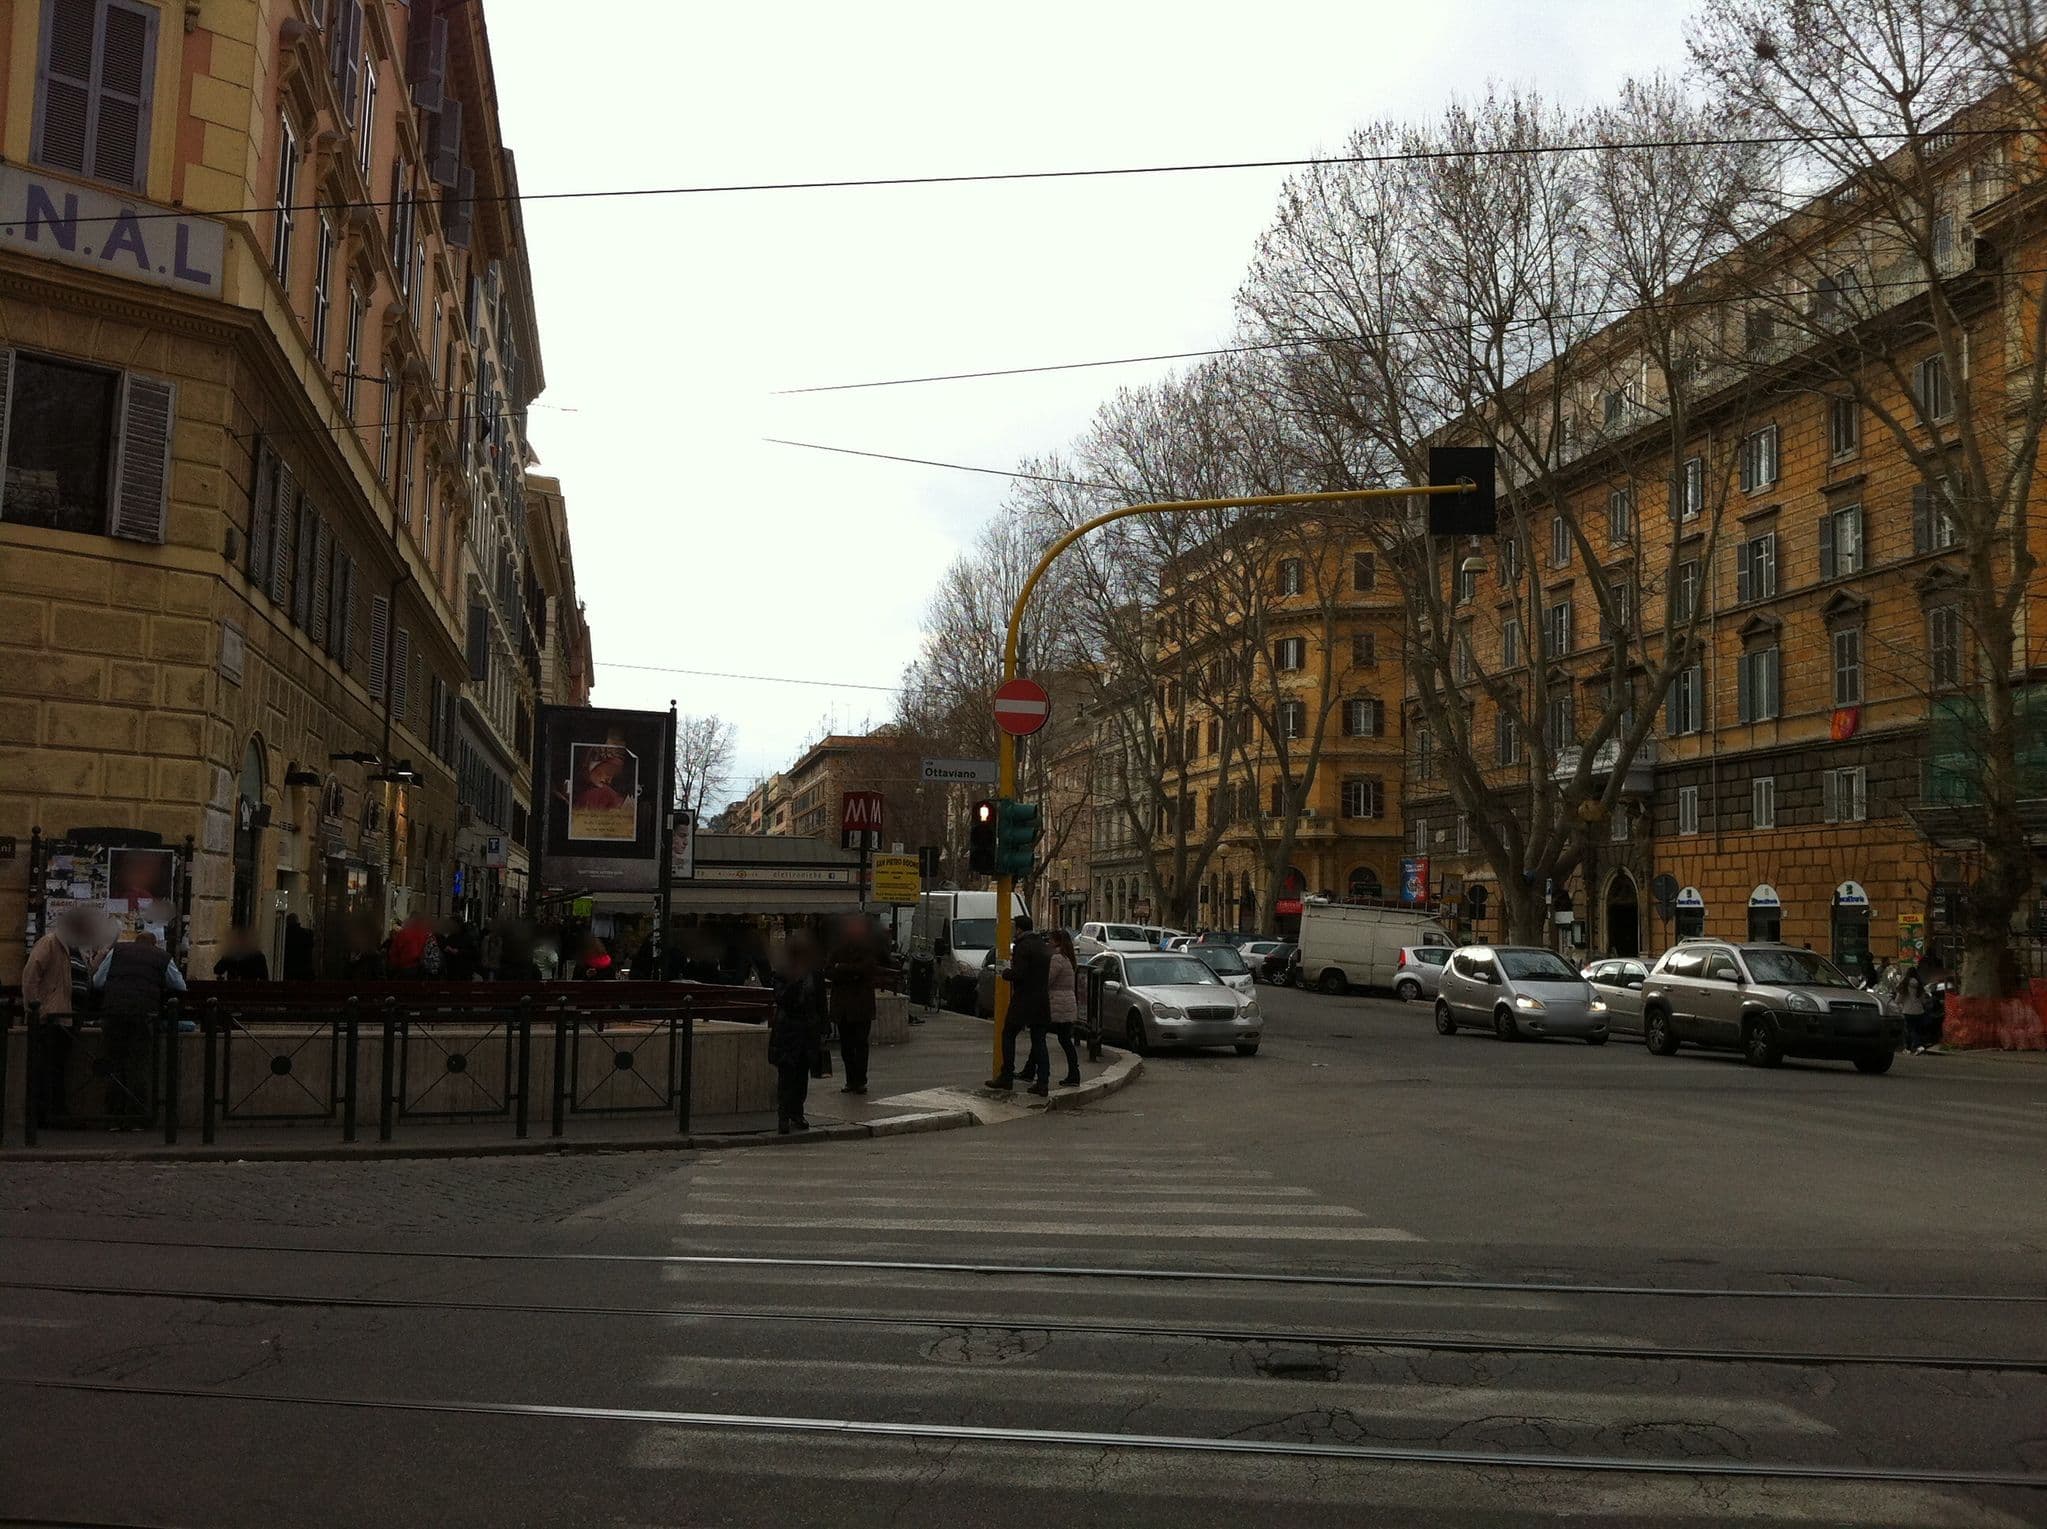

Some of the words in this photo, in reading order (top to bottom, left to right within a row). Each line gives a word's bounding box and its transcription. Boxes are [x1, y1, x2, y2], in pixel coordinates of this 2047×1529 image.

[925, 767, 976, 779] Ottaviano
[845, 798, 867, 824] M
[871, 798, 881, 824] M
